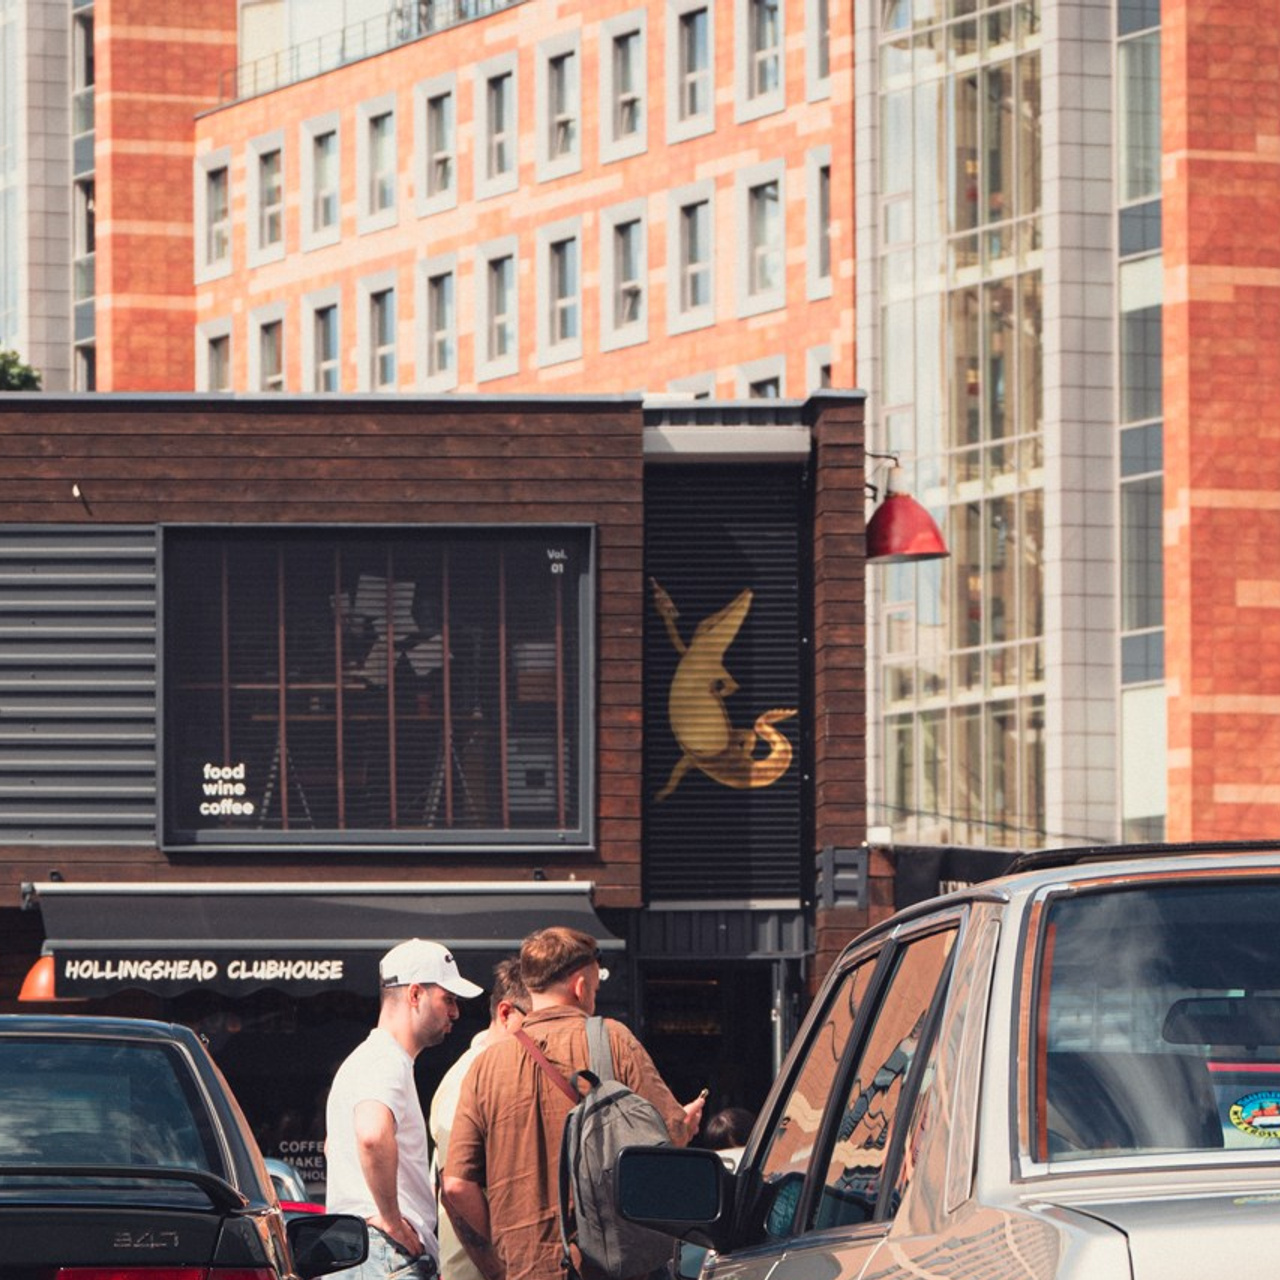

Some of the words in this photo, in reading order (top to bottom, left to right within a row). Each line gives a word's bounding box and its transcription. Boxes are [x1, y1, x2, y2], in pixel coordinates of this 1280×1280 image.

[547, 548, 568, 559] Vol.
[551, 563, 564, 573] 01
[203, 762, 245, 780] food
[202, 779, 246, 796] wine
[199, 798, 254, 816] coffee
[65, 959, 218, 982] HOLLINGSHEAD
[227, 960, 344, 980] CLUBHOUSE
[279, 1140, 325, 1153] COFFE
